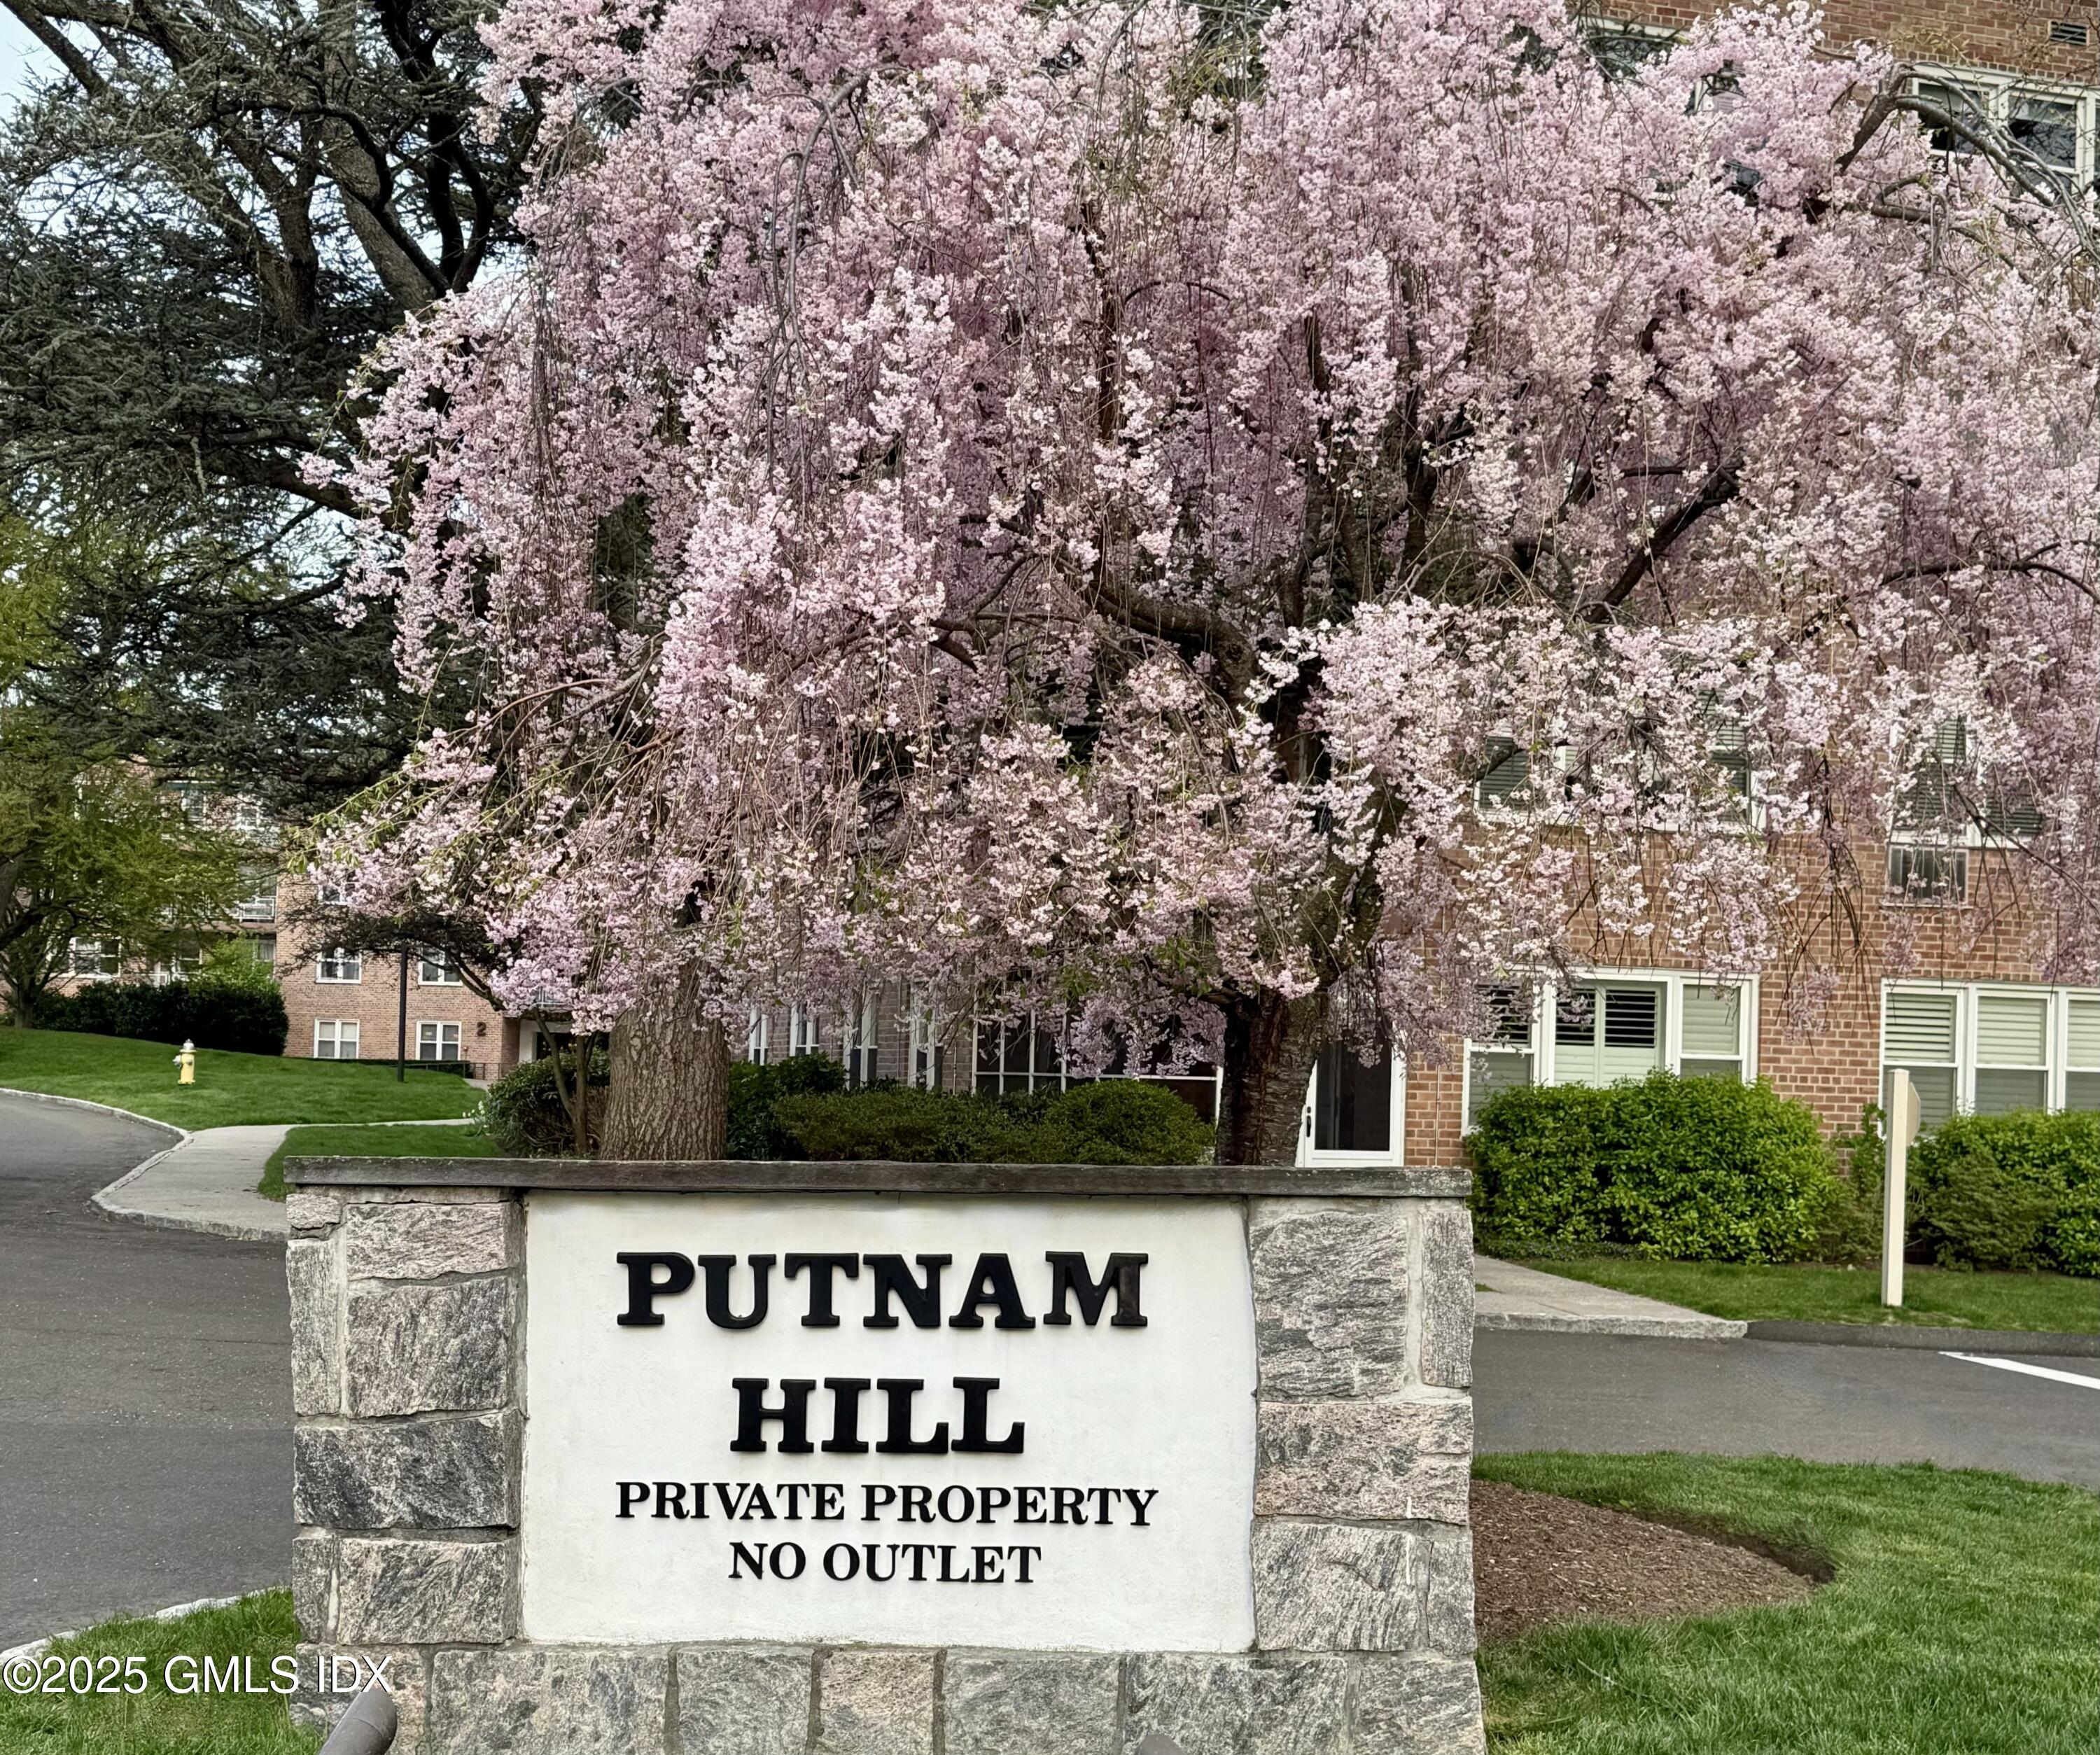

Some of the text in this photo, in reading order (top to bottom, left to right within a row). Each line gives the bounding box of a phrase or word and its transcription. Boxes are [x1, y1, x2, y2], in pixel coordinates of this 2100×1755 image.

[476, 1021, 487, 1037] 2
[616, 1250, 1149, 1332] PUTNAM
[729, 1376, 1026, 1457] HILL
[615, 1481, 1159, 1527] PRIVATE PROPERTY
[728, 1541, 1042, 1583] NO OUTLET
